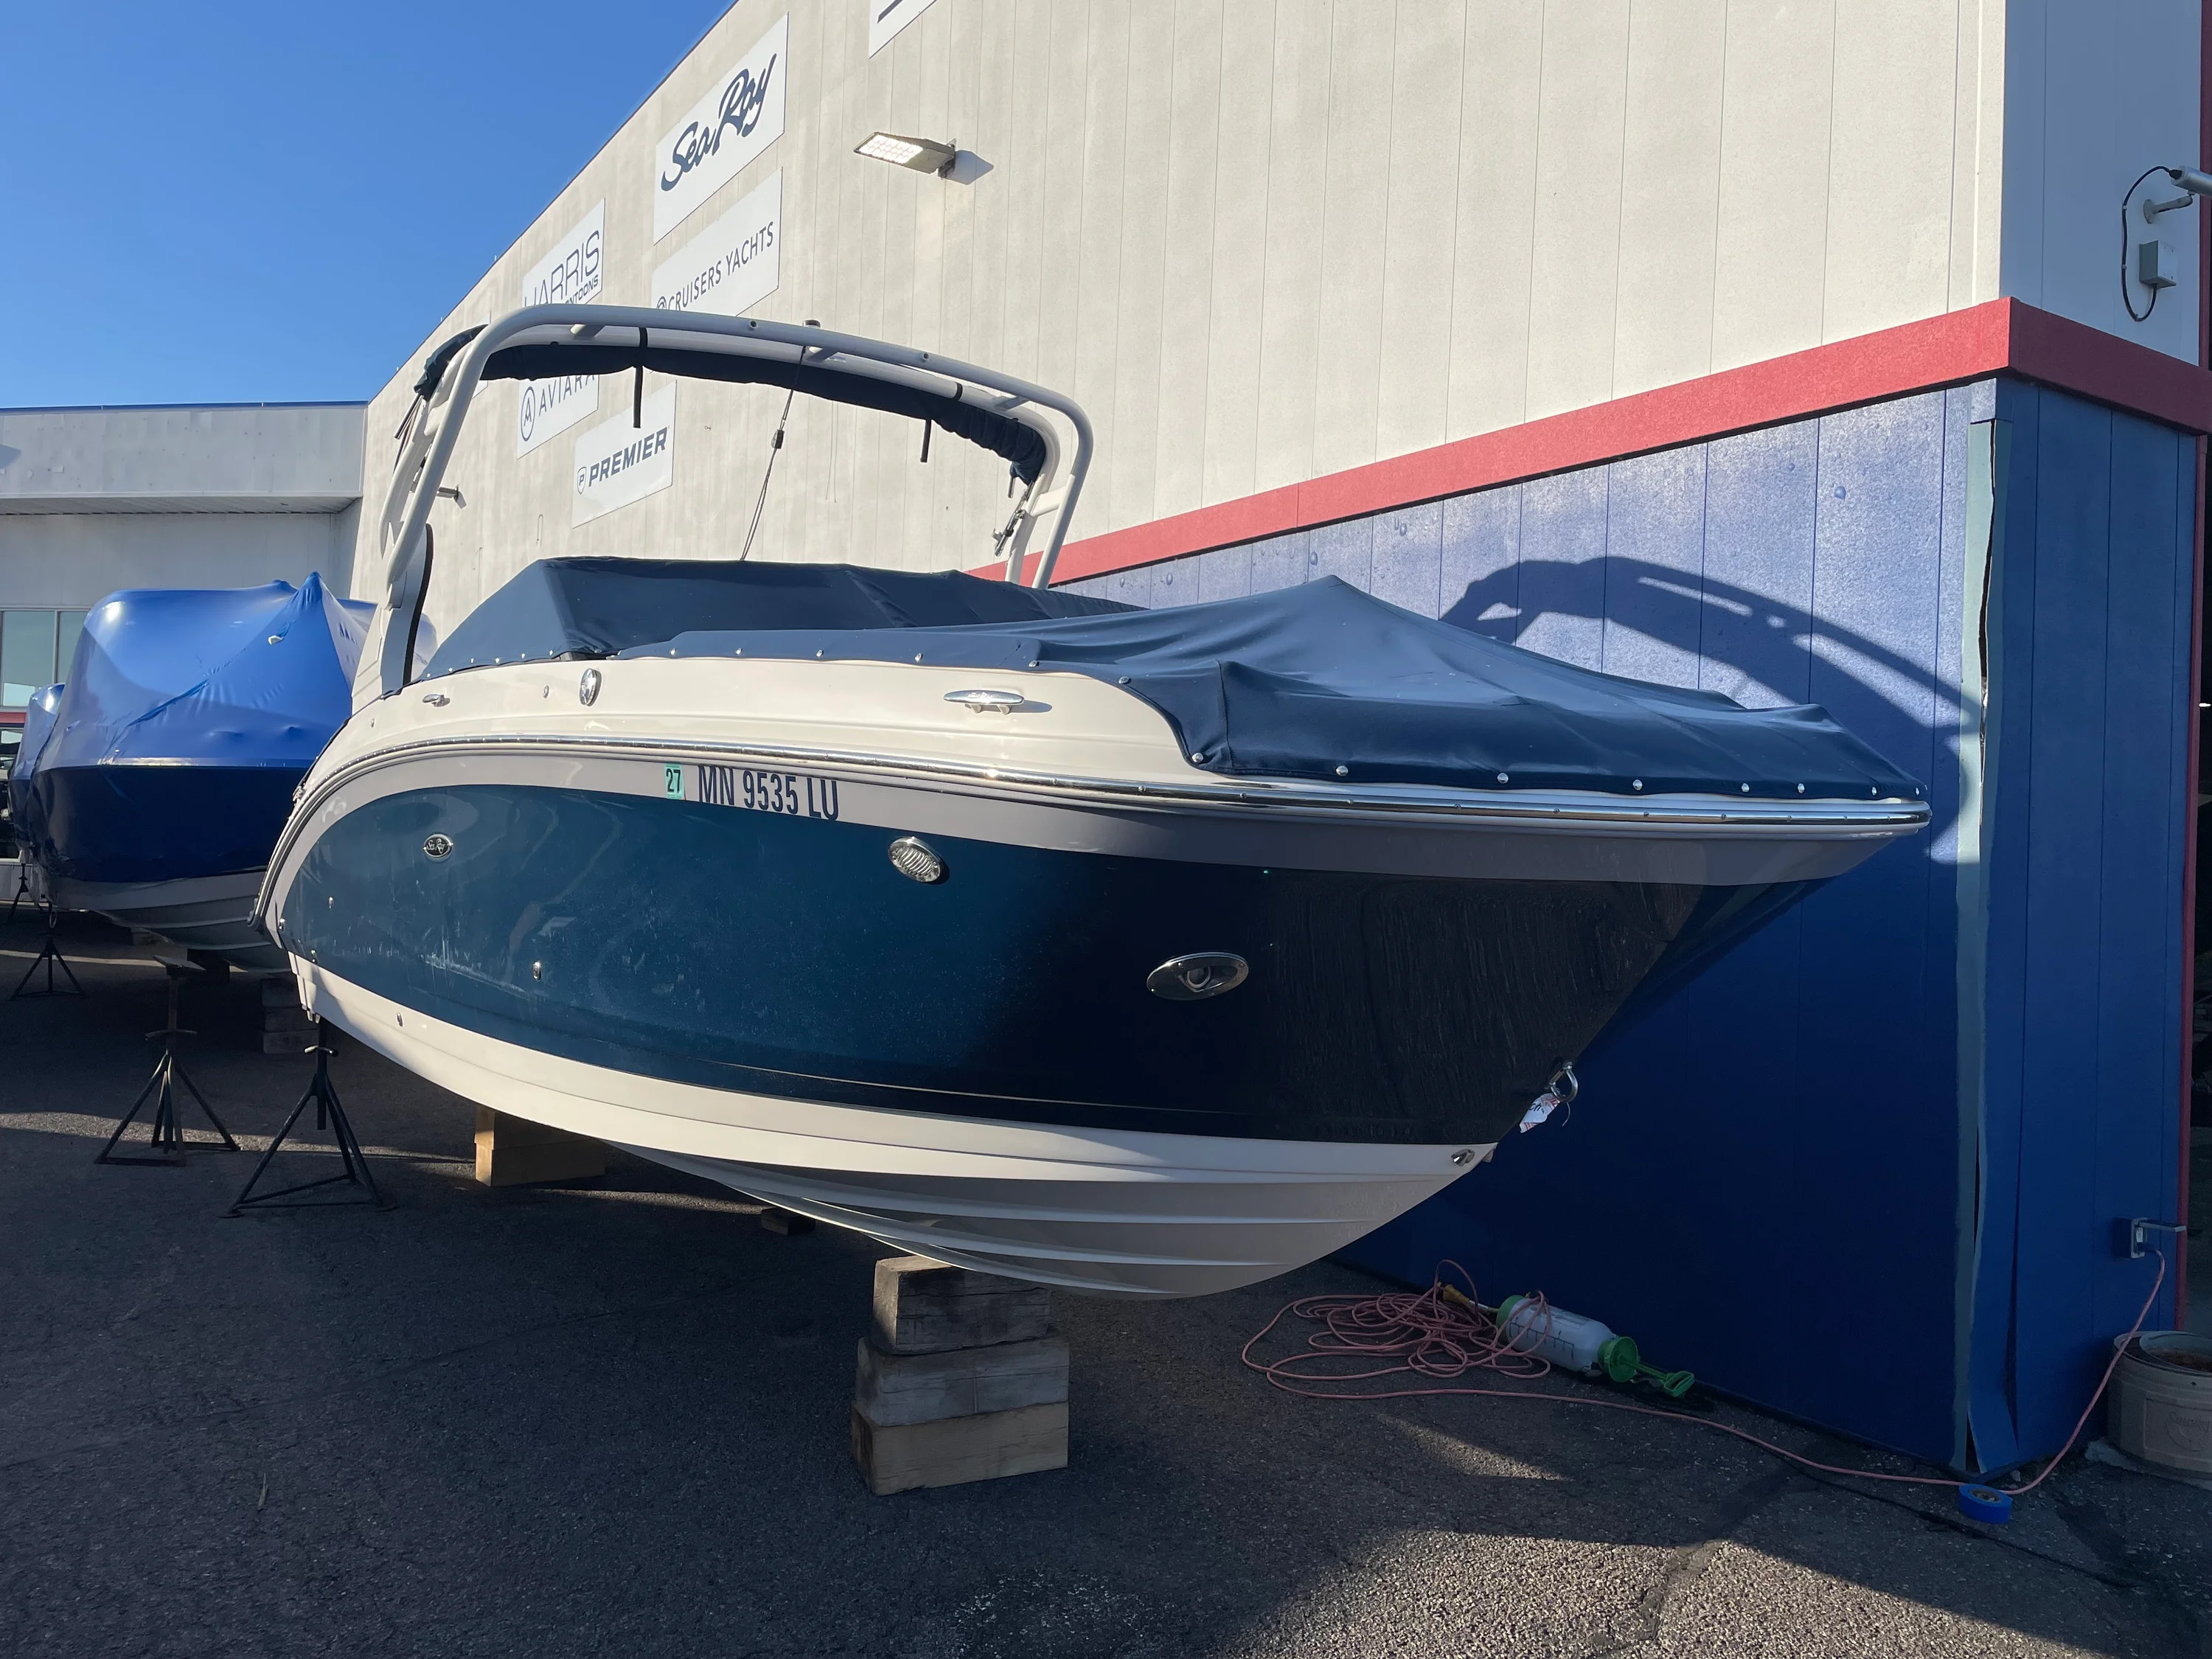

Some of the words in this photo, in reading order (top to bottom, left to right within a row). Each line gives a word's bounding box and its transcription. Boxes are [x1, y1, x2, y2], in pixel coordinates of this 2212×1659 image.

[661, 121, 717, 192] Sea
[712, 53, 777, 156] Ray
[566, 274, 599, 305] NTOONS
[668, 260, 722, 310] CRUISERS
[726, 221, 773, 276] YACHTS
[588, 427, 668, 487] PREMIER
[666, 768, 681, 793] 27
[698, 765, 735, 806] MN
[742, 770, 799, 815] 9535
[807, 777, 839, 821] LU
